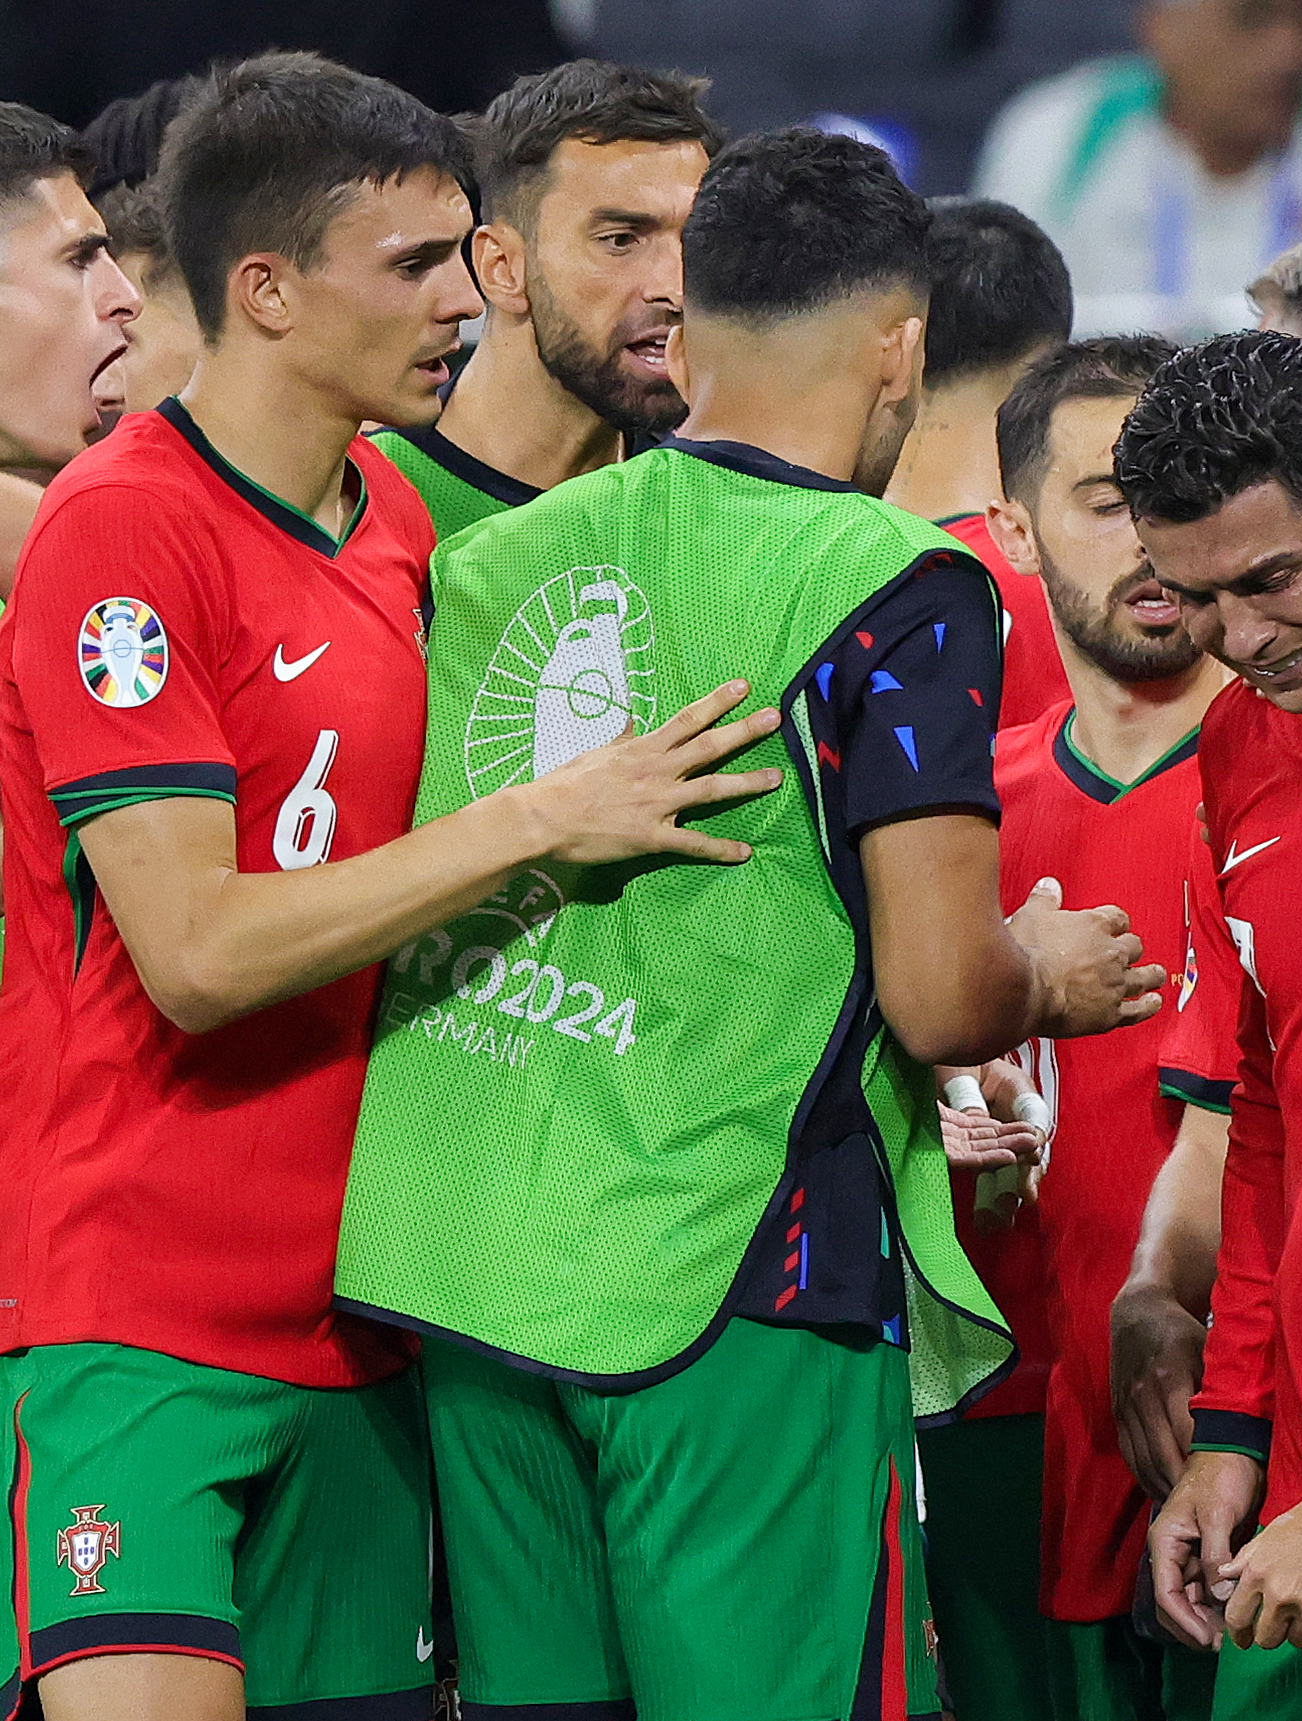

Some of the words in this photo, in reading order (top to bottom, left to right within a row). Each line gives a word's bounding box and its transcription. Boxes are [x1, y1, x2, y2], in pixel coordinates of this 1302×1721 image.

[273, 729, 339, 871] 6
[385, 991, 536, 1070] ERMANY
[393, 928, 638, 1057] RO2024
